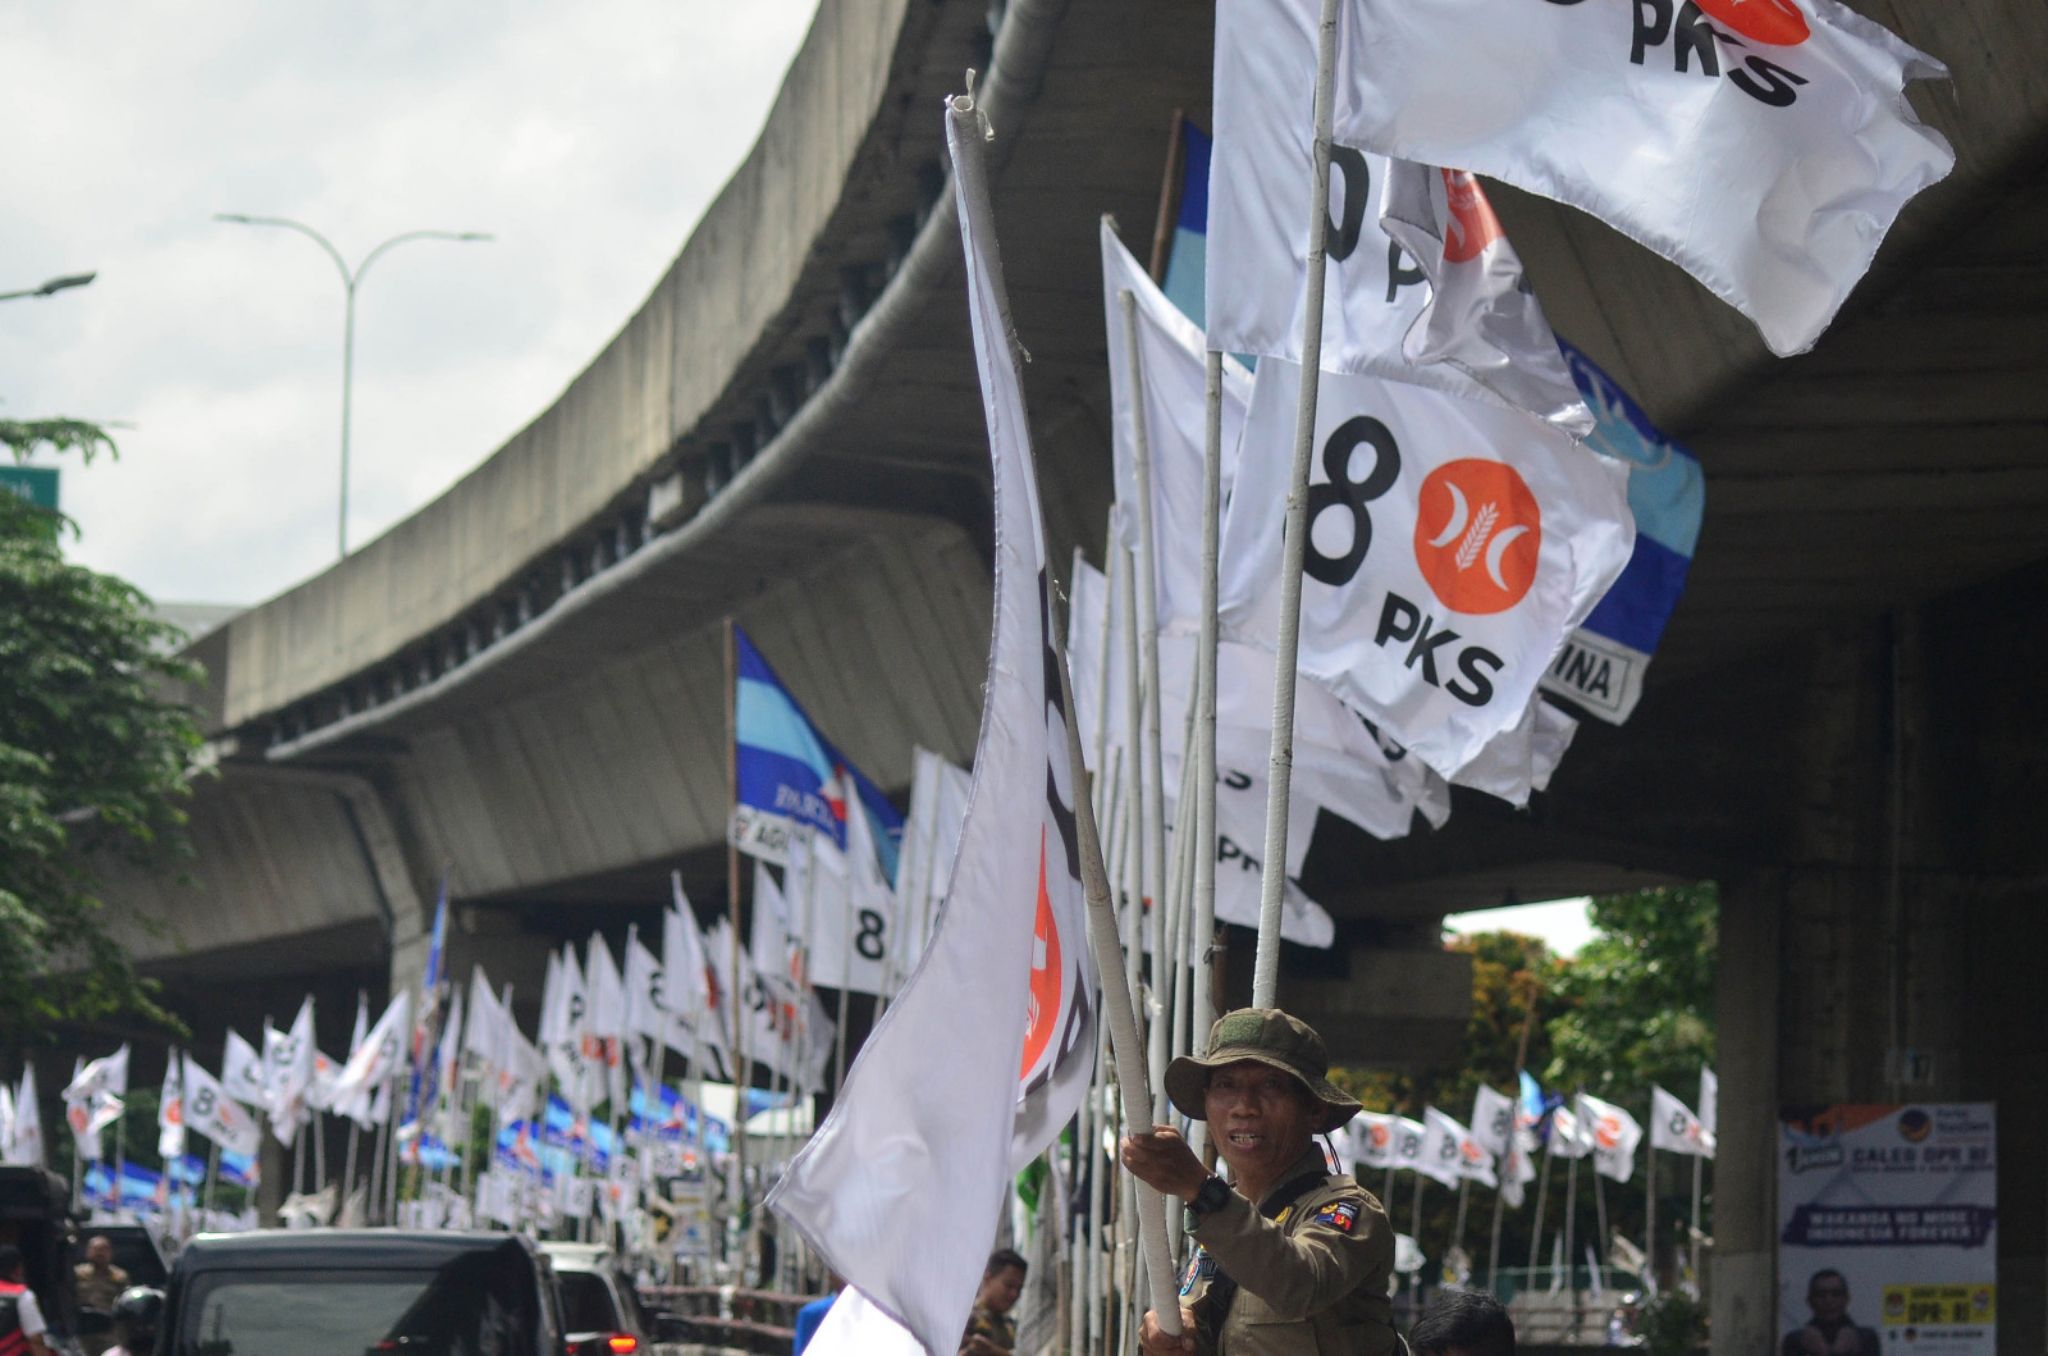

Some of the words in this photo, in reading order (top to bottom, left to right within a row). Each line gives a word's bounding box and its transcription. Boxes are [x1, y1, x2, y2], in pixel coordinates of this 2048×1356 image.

[1283, 415, 1401, 586] 8
[1373, 591, 1505, 706] PKS
[855, 908, 886, 960] 8
